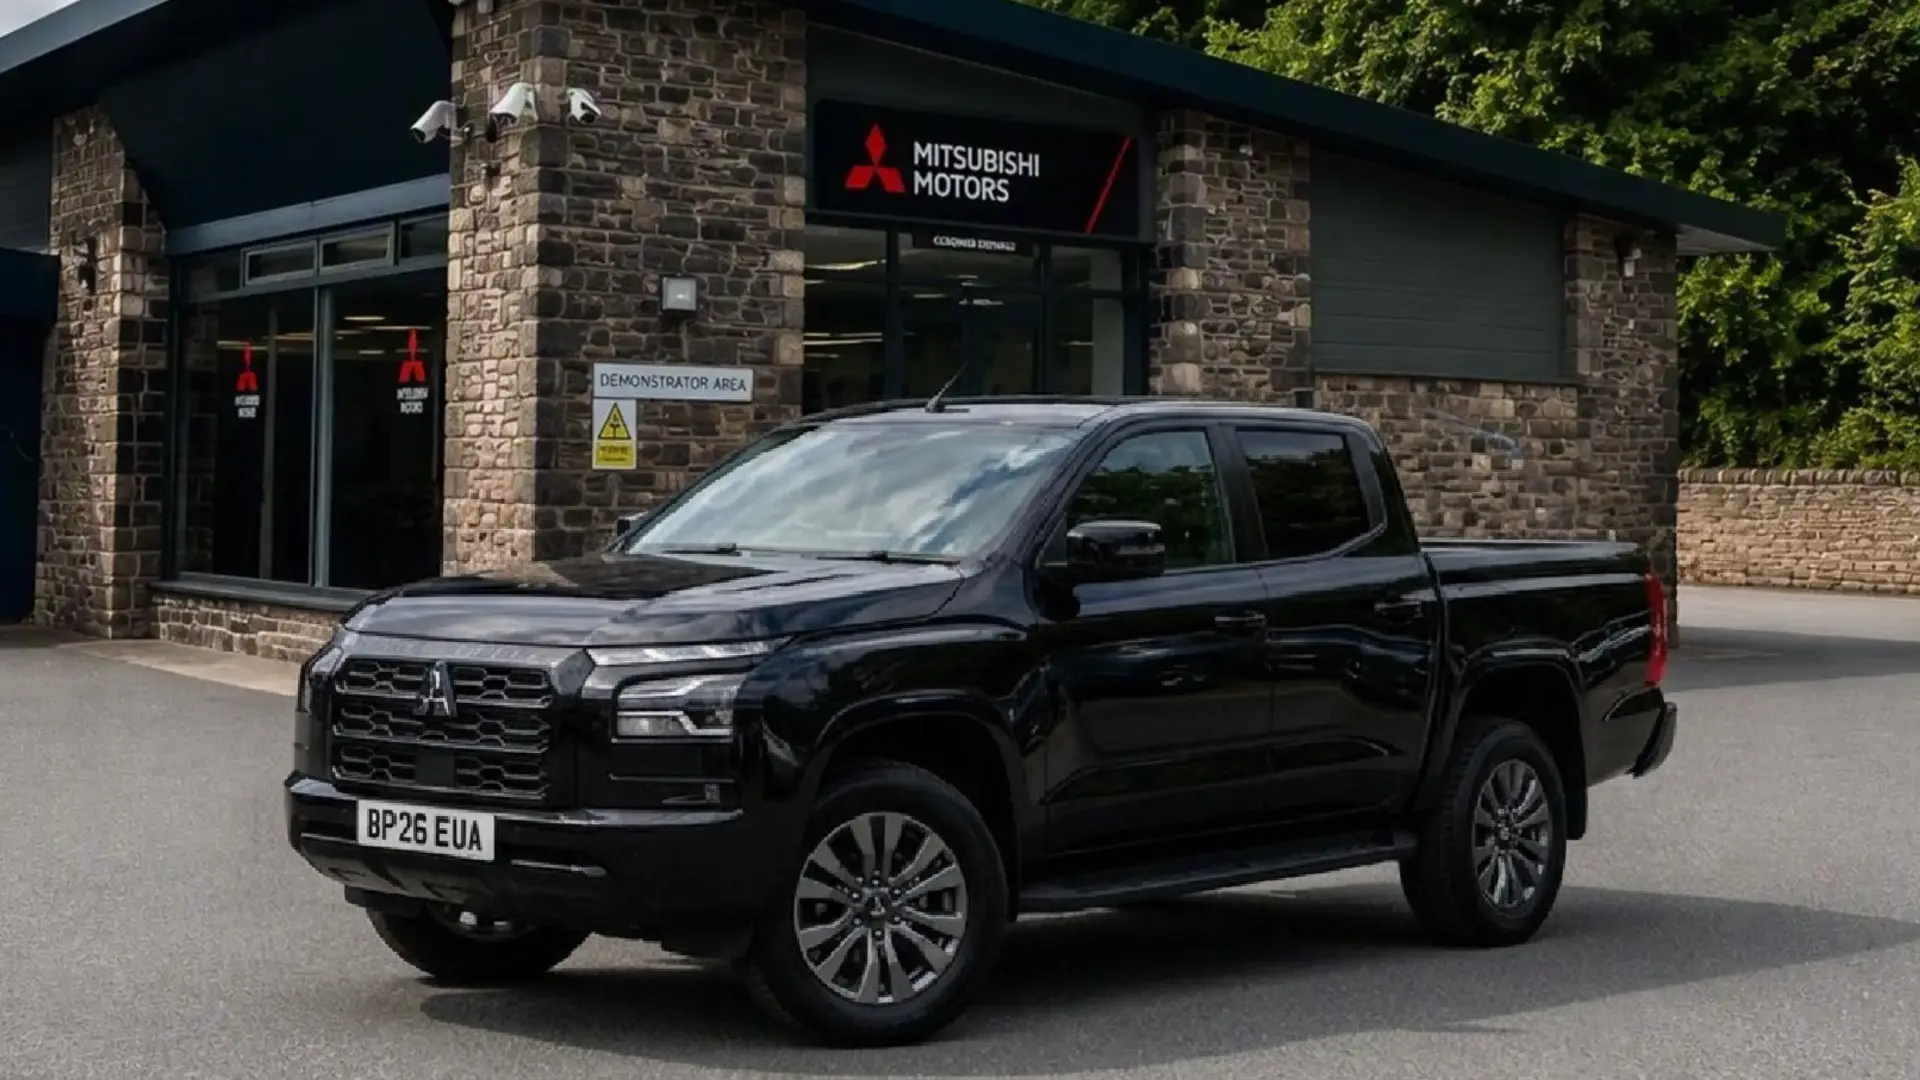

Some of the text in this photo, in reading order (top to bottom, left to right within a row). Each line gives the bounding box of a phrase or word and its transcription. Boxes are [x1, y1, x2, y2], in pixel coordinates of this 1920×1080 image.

[913, 140, 1040, 177] MITSUBISHI
[913, 170, 1009, 202] MOTORS
[600, 373, 747, 392] DEMONSTRATOR AREA
[367, 808, 482, 851] BP26 EUA
